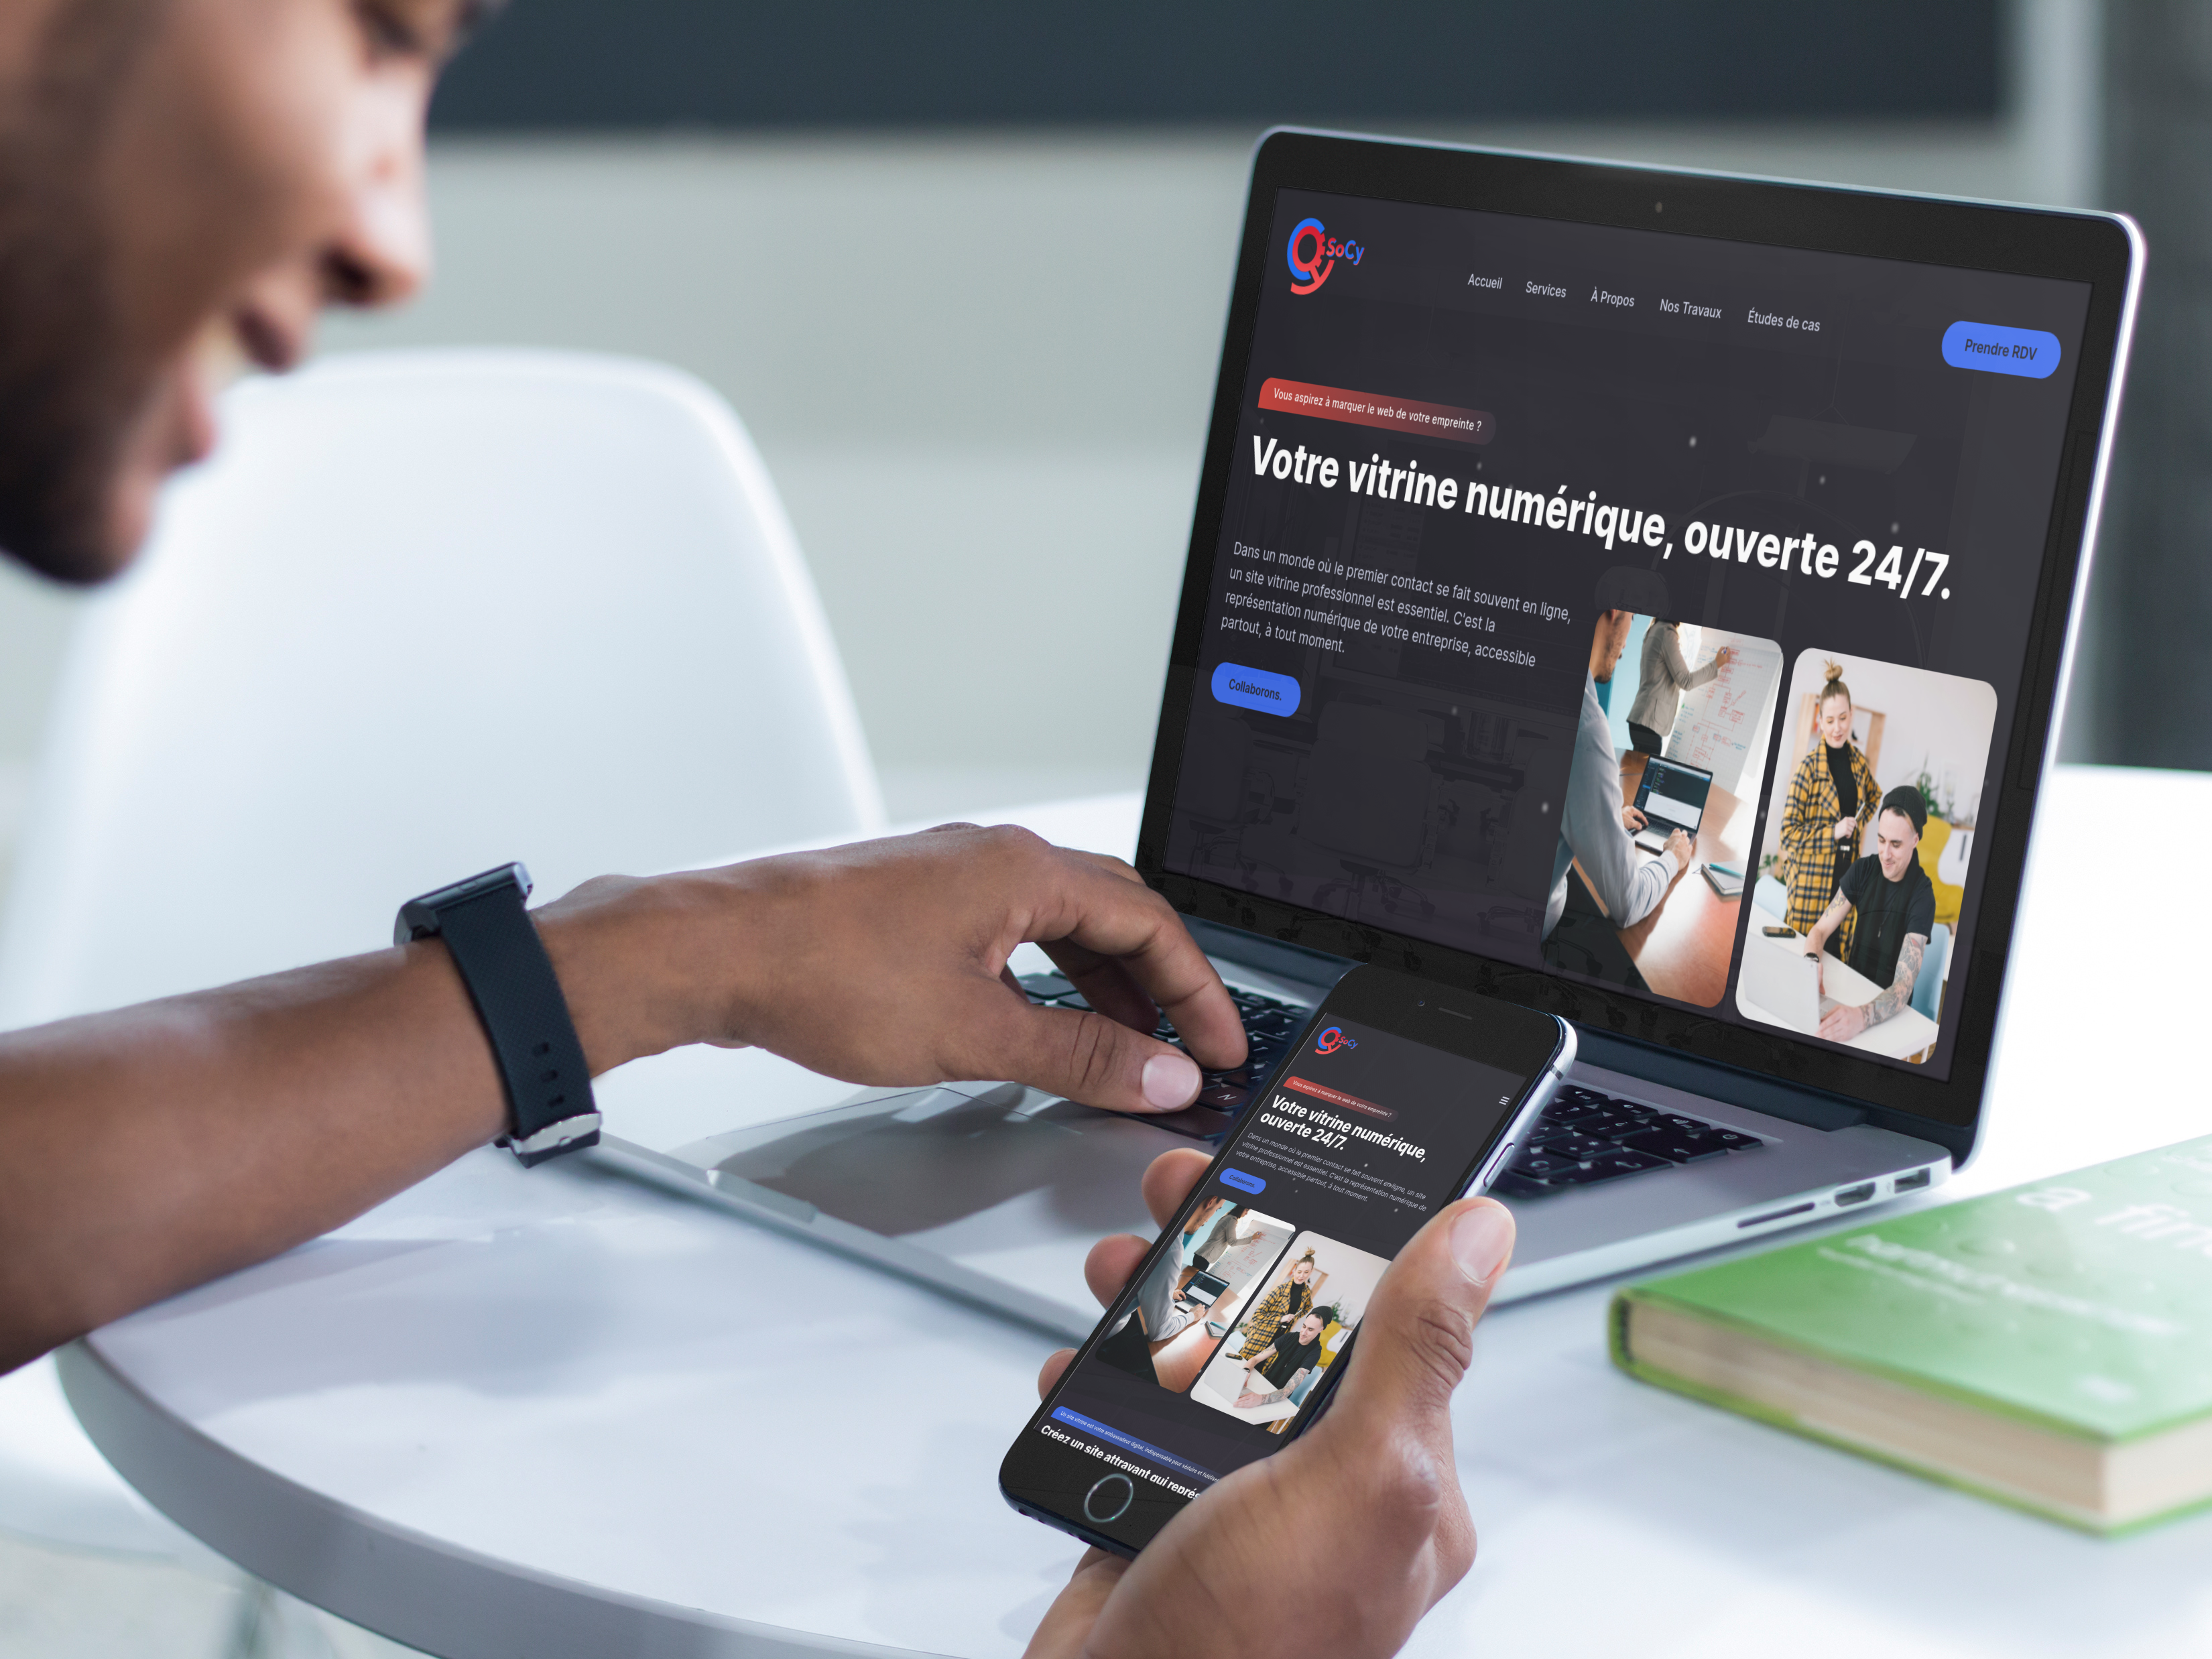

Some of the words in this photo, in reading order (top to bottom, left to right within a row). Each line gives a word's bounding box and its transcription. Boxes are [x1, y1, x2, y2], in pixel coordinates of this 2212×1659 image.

[1325, 237, 1365, 266] SoCy
[1467, 273, 1503, 290] Accueil
[1526, 281, 1566, 298] Services
[1590, 286, 1598, 302] À
[1600, 290, 1635, 308] Propos
[1660, 298, 1680, 313] Nos
[1682, 301, 1722, 319] Travaux
[1747, 306, 1784, 327] Études
[1786, 315, 1800, 329] de
[1801, 320, 1821, 332] cas
[1964, 339, 2010, 357] Prendre
[2012, 345, 2038, 361] RDV
[1274, 387, 1293, 401] Vous
[1294, 393, 1324, 406] aspirez
[1325, 395, 1331, 408] à
[1331, 400, 1366, 414] marquer
[1367, 403, 1375, 414] le
[1377, 406, 1394, 418] web
[1396, 408, 1407, 420] de
[1409, 412, 1430, 424] votre
[1432, 416, 1475, 431] empreinte
[1477, 420, 1482, 432] ?
[1253, 434, 1340, 488] Votre
[1349, 453, 1458, 509] vitrine
[1465, 481, 1673, 560] numérique,
[1684, 521, 1839, 578] ouverte
[1847, 540, 1951, 600] 24/7.
[1229, 568, 1243, 581] un
[1245, 570, 1264, 585] site
[1268, 574, 1300, 593] vitrine
[1301, 582, 1375, 608] professionnel
[1377, 598, 1395, 612] est
[1397, 602, 1449, 623] essentiel.
[1453, 611, 1483, 630] C'est
[1485, 617, 1495, 633] la
[1233, 541, 1260, 559] Dans
[1263, 550, 1276, 562] un
[1278, 552, 1315, 570] monde
[1317, 558, 1332, 574] où
[1334, 561, 1344, 576] le
[1345, 566, 1389, 585] premier
[1391, 575, 1434, 594] contact
[1436, 584, 1450, 597] se
[1453, 585, 1471, 601] fait
[1473, 591, 1520, 611] souvent
[1522, 601, 1537, 615] en
[1540, 601, 1571, 625] ligne,
[1221, 616, 1262, 639] partout,
[1265, 621, 1272, 637] à
[1275, 625, 1296, 643] tout
[1298, 633, 1345, 653] moment.
[1225, 592, 1301, 618] représentation
[1304, 608, 1361, 631] numérique
[1363, 619, 1377, 634] de
[1381, 624, 1409, 641] votre
[1412, 631, 1471, 658] entreprise,
[1475, 644, 1536, 667] accessible
[1229, 678, 1282, 701] Collaborons.
[1339, 1036, 1359, 1050] SoCy
[1272, 1095, 1308, 1117] Votre
[1308, 1109, 1352, 1133] vitrine
[1351, 1125, 1426, 1163] numérique,
[1367, 1107, 1388, 1116] empreinte
[1259, 1113, 1312, 1138] ouverte
[1310, 1128, 1348, 1150] 24/7.
[1235, 1150, 1250, 1159] votre
[1249, 1156, 1277, 1170] entreprise,
[1278, 1166, 1306, 1180] accessible
[1304, 1176, 1327, 1188] partout,
[1333, 1184, 1345, 1193] tout
[1344, 1189, 1368, 1202] moment.
[1242, 1142, 1259, 1151] vitrine
[1257, 1148, 1295, 1164] professionnel
[1303, 1164, 1329, 1176] essentiel.
[1329, 1172, 1344, 1182] C'est
[1349, 1180, 1389, 1198] représentation
[1388, 1194, 1418, 1209] numérique
[1247, 1132, 1262, 1142] Dans
[1269, 1140, 1288, 1151] monde
[1300, 1152, 1323, 1163] premier
[1323, 1160, 1344, 1171] contact
[1351, 1169, 1361, 1177] fait
[1361, 1173, 1384, 1185] souvent
[1391, 1183, 1406, 1194] ligne,
[1229, 1174, 1255, 1188] Collaborons.
[1041, 1425, 1071, 1444] Créez
[1070, 1438, 1085, 1451] un
[1084, 1445, 1104, 1459] site
[1105, 1431, 1131, 1444] ambassadeur
[1131, 1442, 1144, 1451] digital,
[1144, 1447, 1172, 1462] indispensable
[1182, 1465, 1197, 1473] séduire
